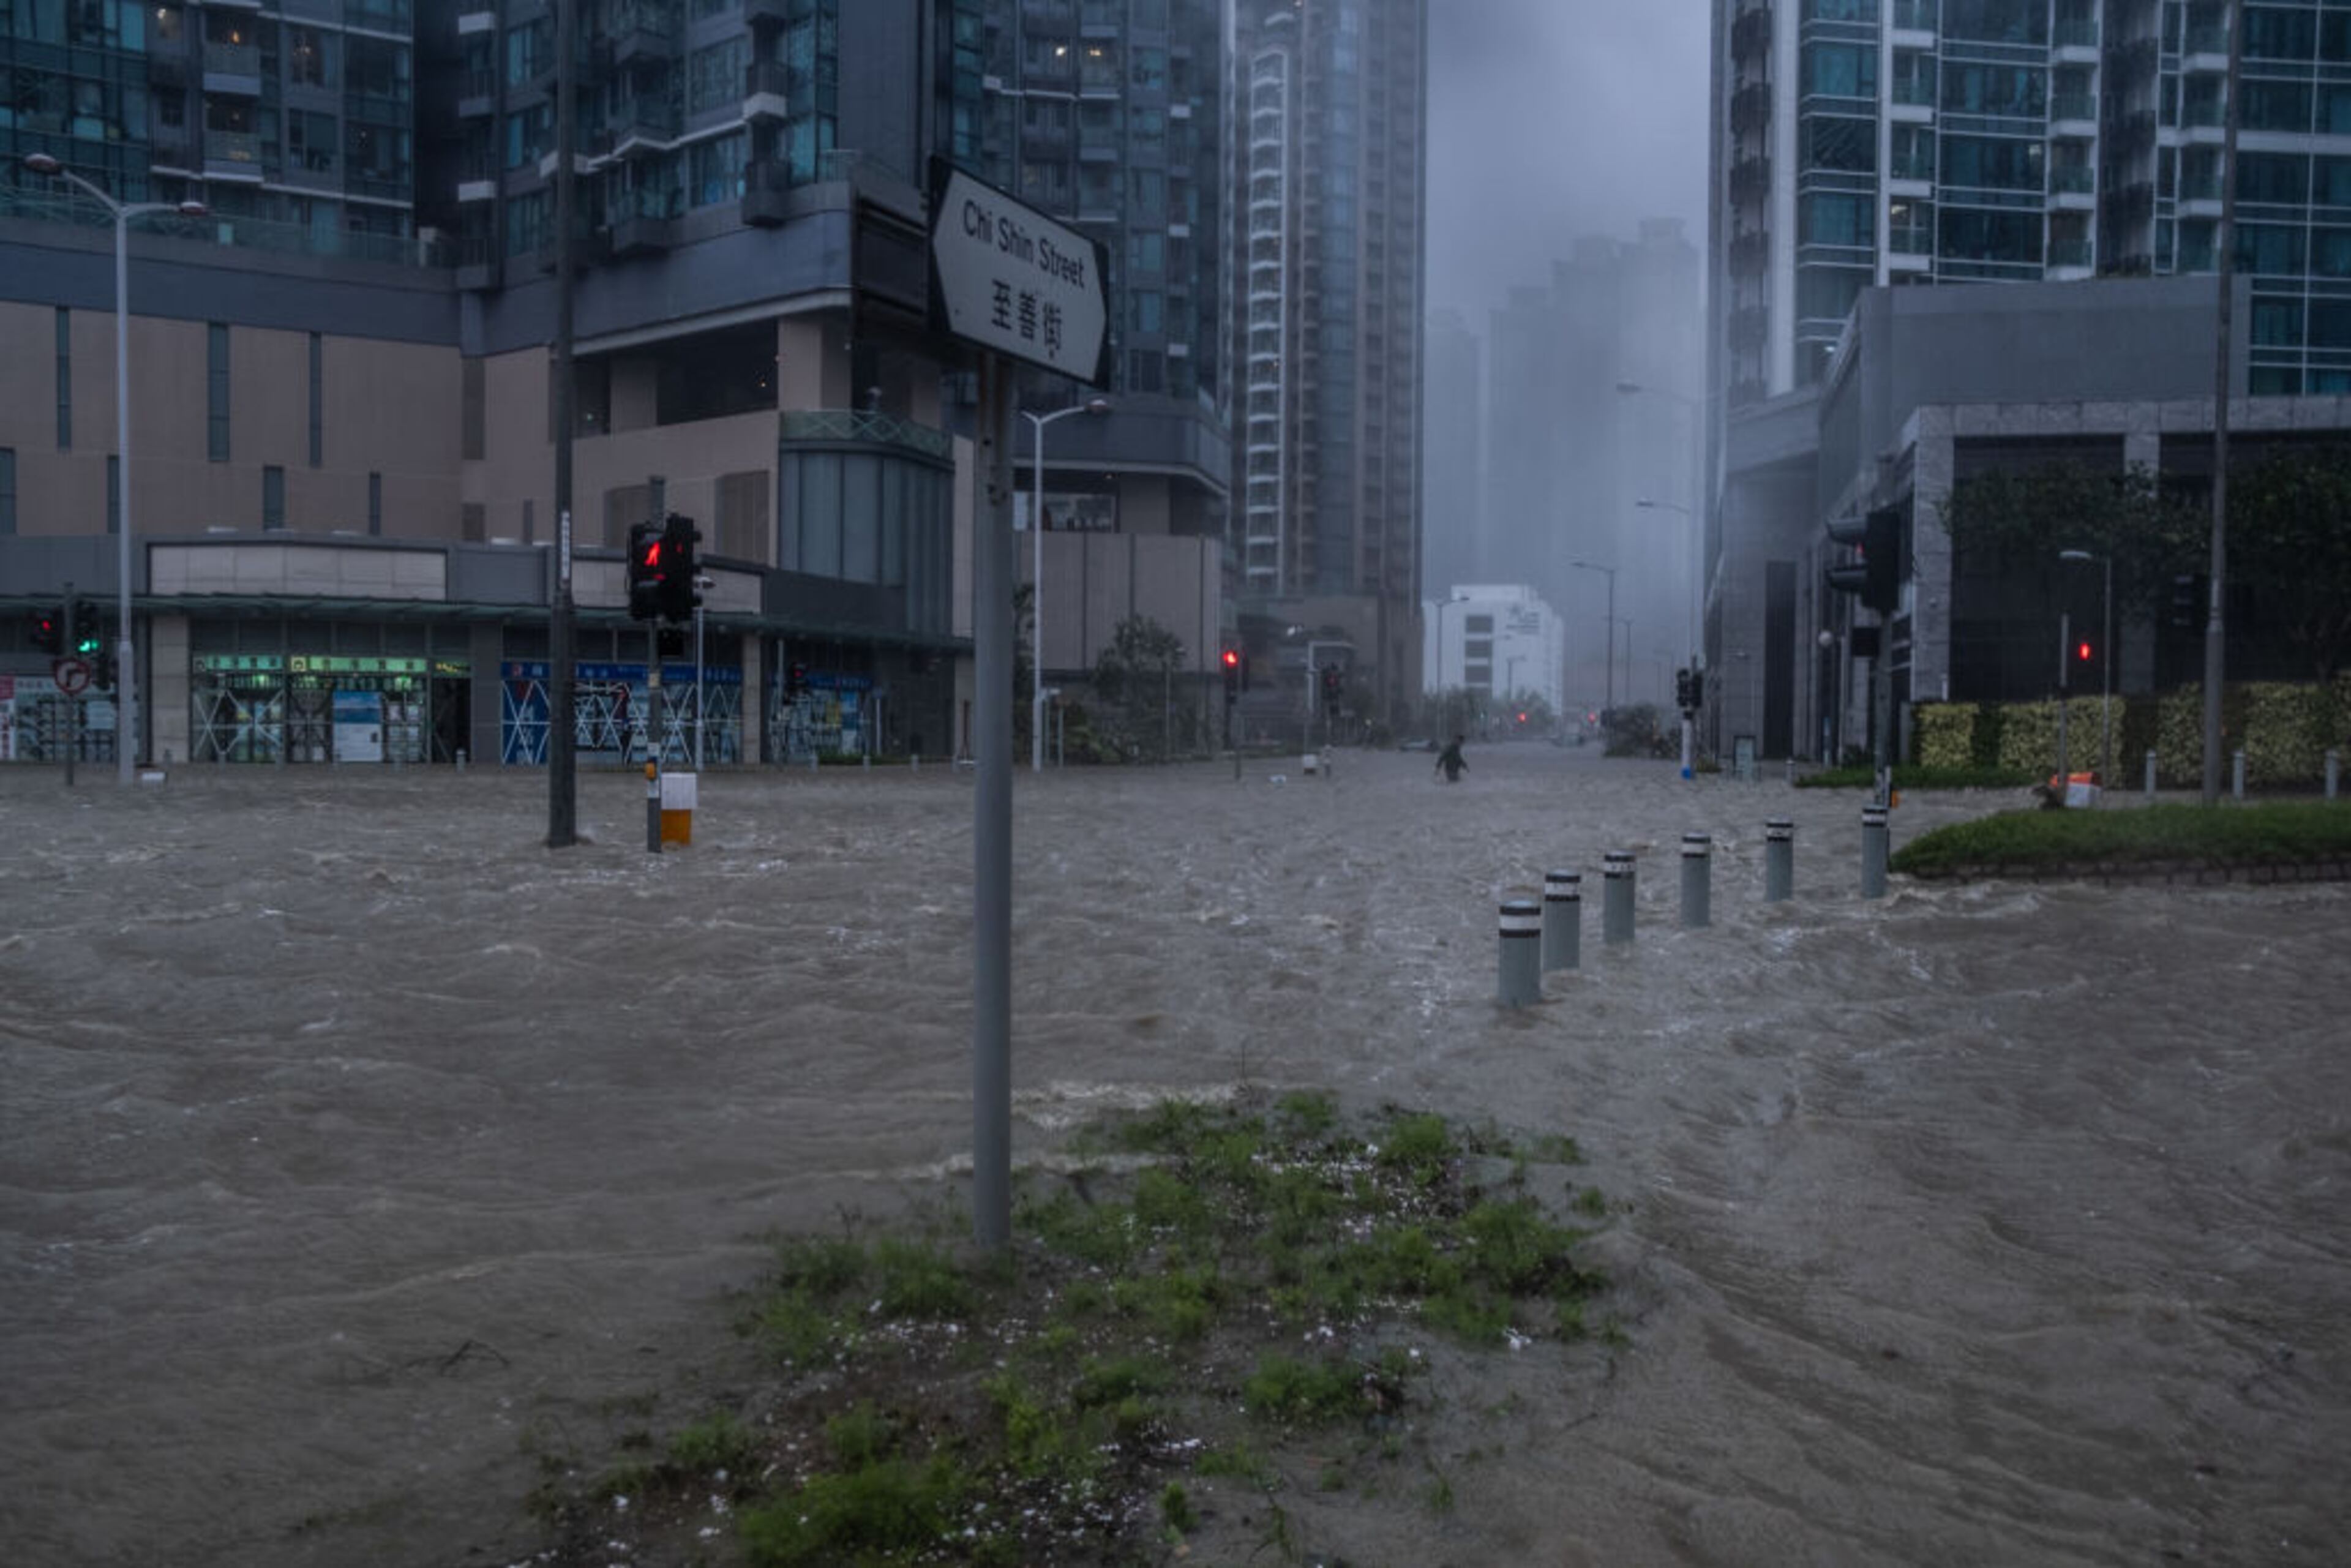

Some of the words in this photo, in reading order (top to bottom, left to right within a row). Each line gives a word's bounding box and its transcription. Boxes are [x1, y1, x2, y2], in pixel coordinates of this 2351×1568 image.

[964, 200, 992, 243] Chi
[998, 217, 1033, 265] Shin
[1040, 238, 1084, 289] Street
[991, 277, 1062, 359] 至善街
